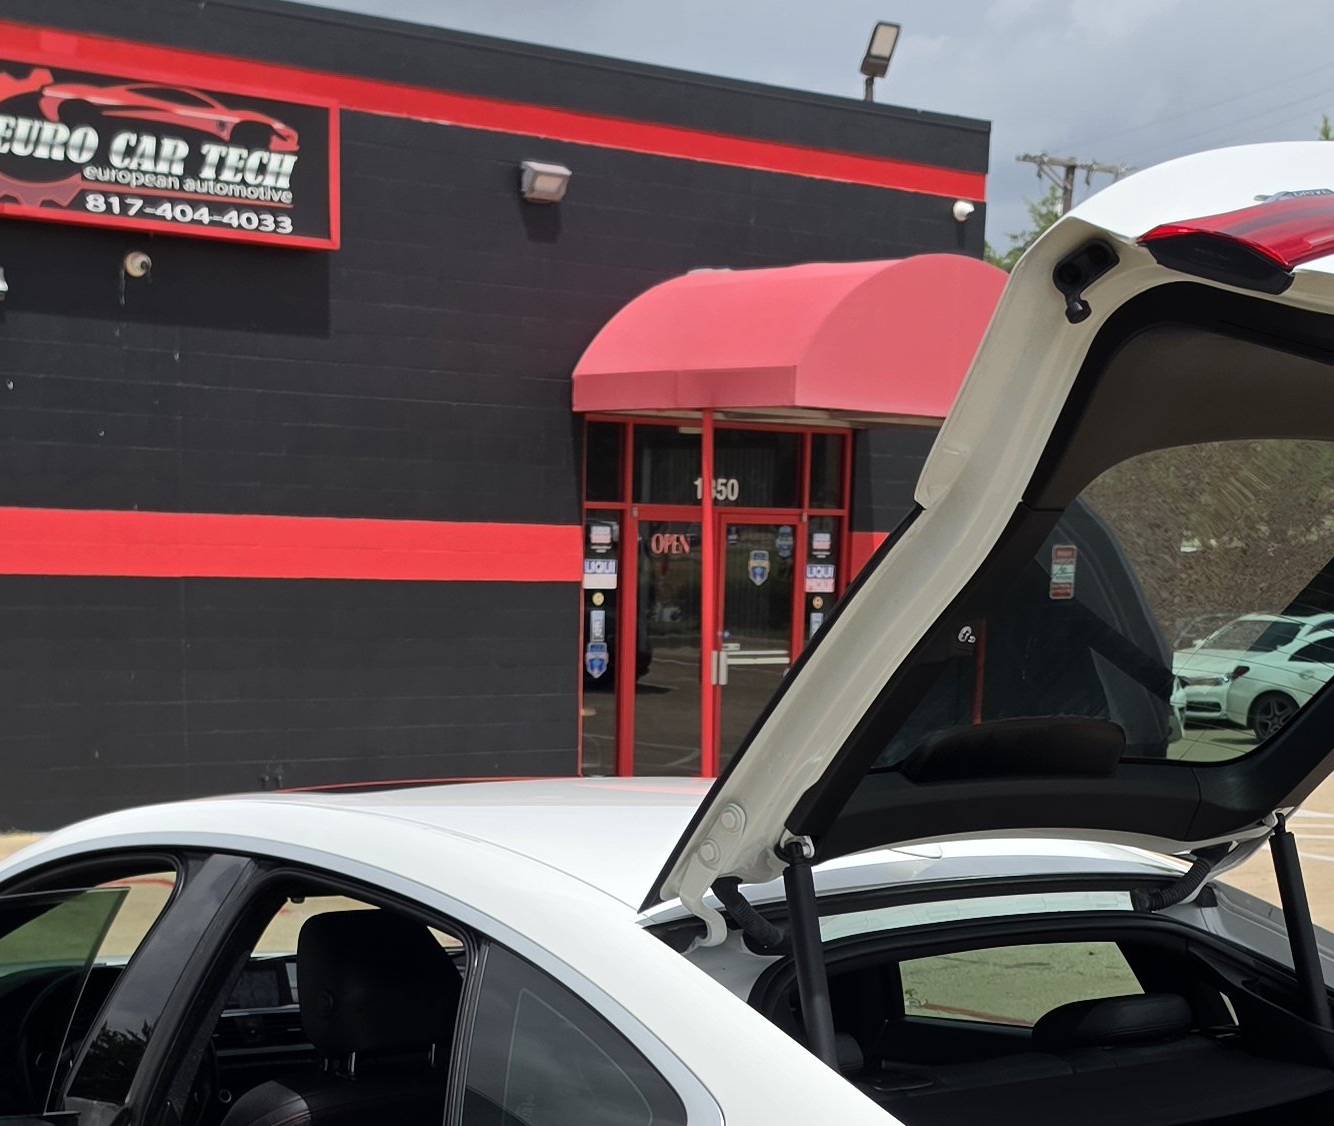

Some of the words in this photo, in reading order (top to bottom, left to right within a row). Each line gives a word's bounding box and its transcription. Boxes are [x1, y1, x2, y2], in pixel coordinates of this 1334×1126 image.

[109, 131, 190, 175] CAR
[200, 143, 298, 189] TECH
[82, 165, 180, 188] european
[182, 178, 294, 205] automotive
[85, 193, 294, 234] 817-404-4033
[650, 533, 691, 555] OPEN
